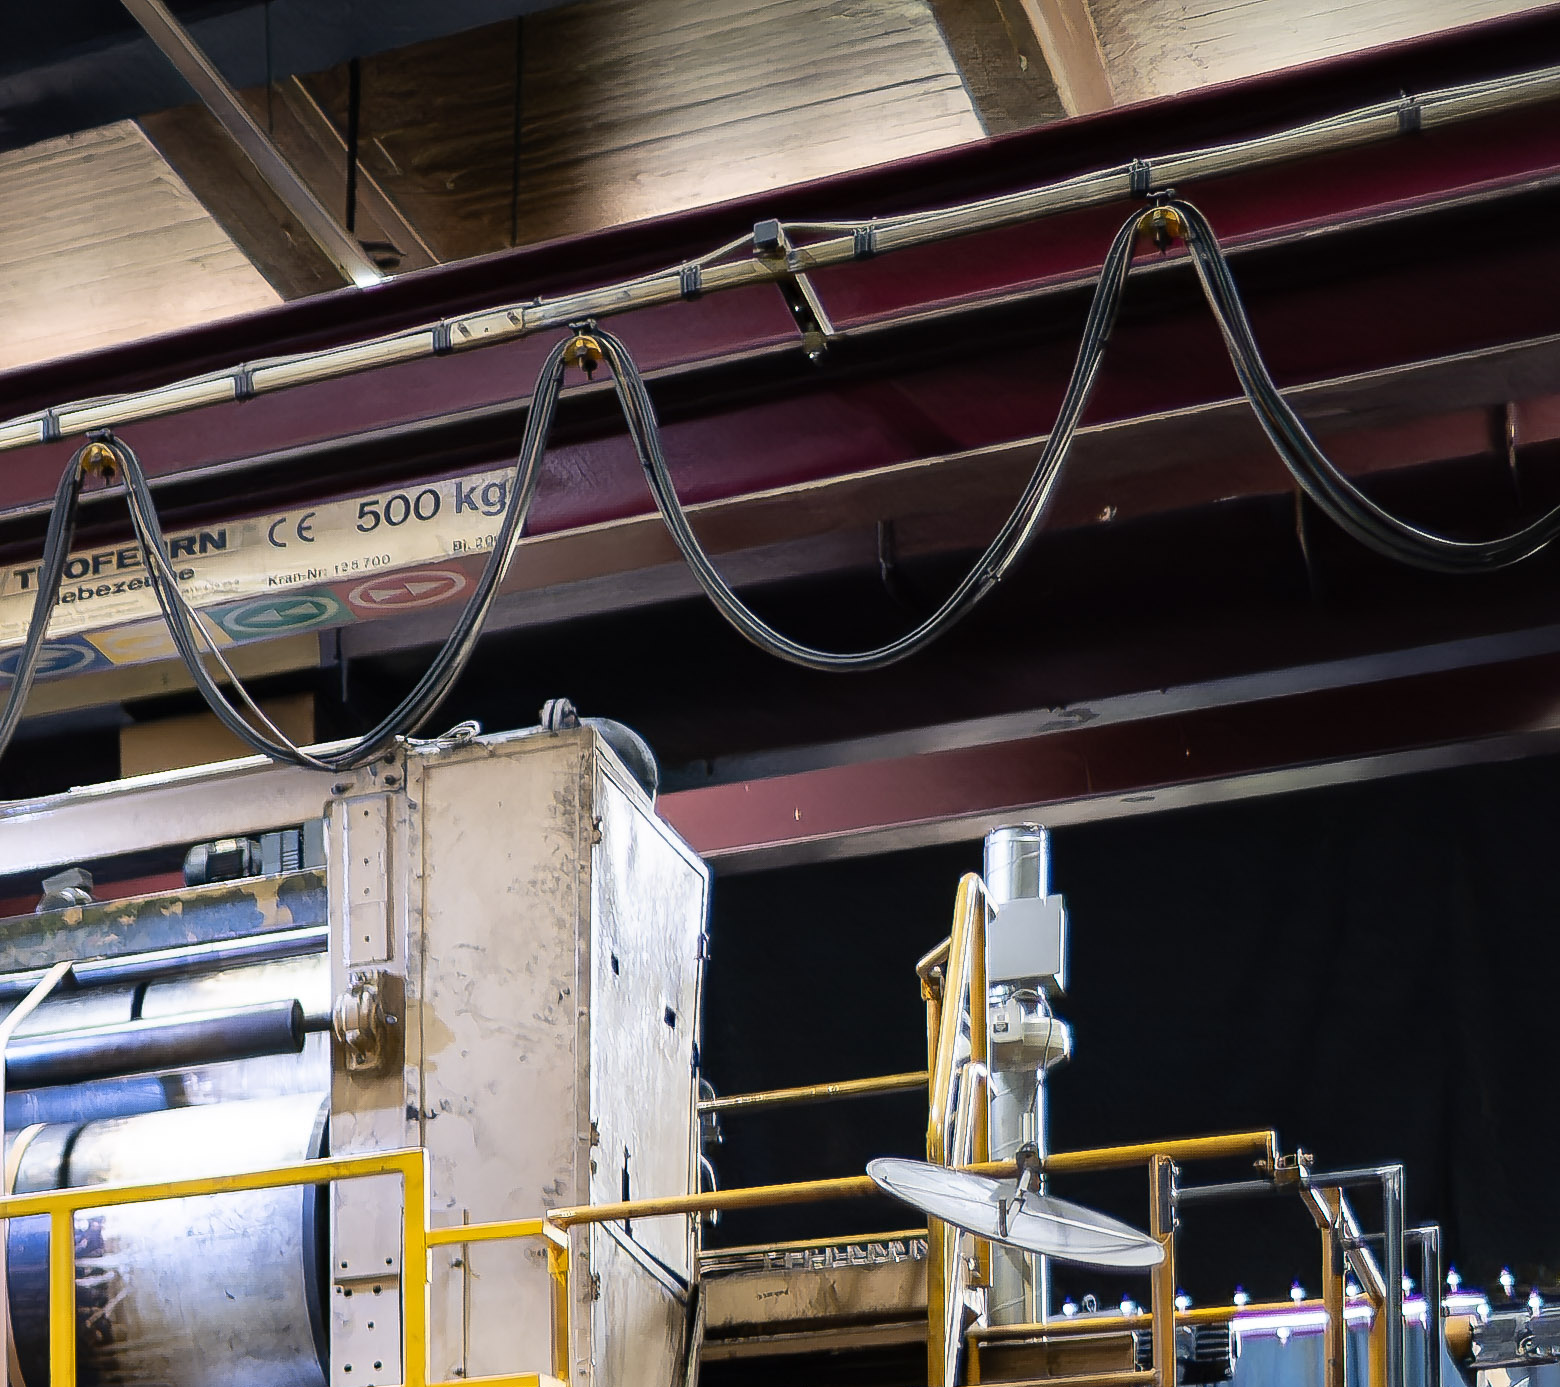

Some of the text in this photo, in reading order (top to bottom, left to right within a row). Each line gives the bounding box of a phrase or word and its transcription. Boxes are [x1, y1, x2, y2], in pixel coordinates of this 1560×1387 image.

[14, 528, 227, 590] TOFERN
[356, 488, 441, 533] 500
[455, 481, 507, 517] kg
